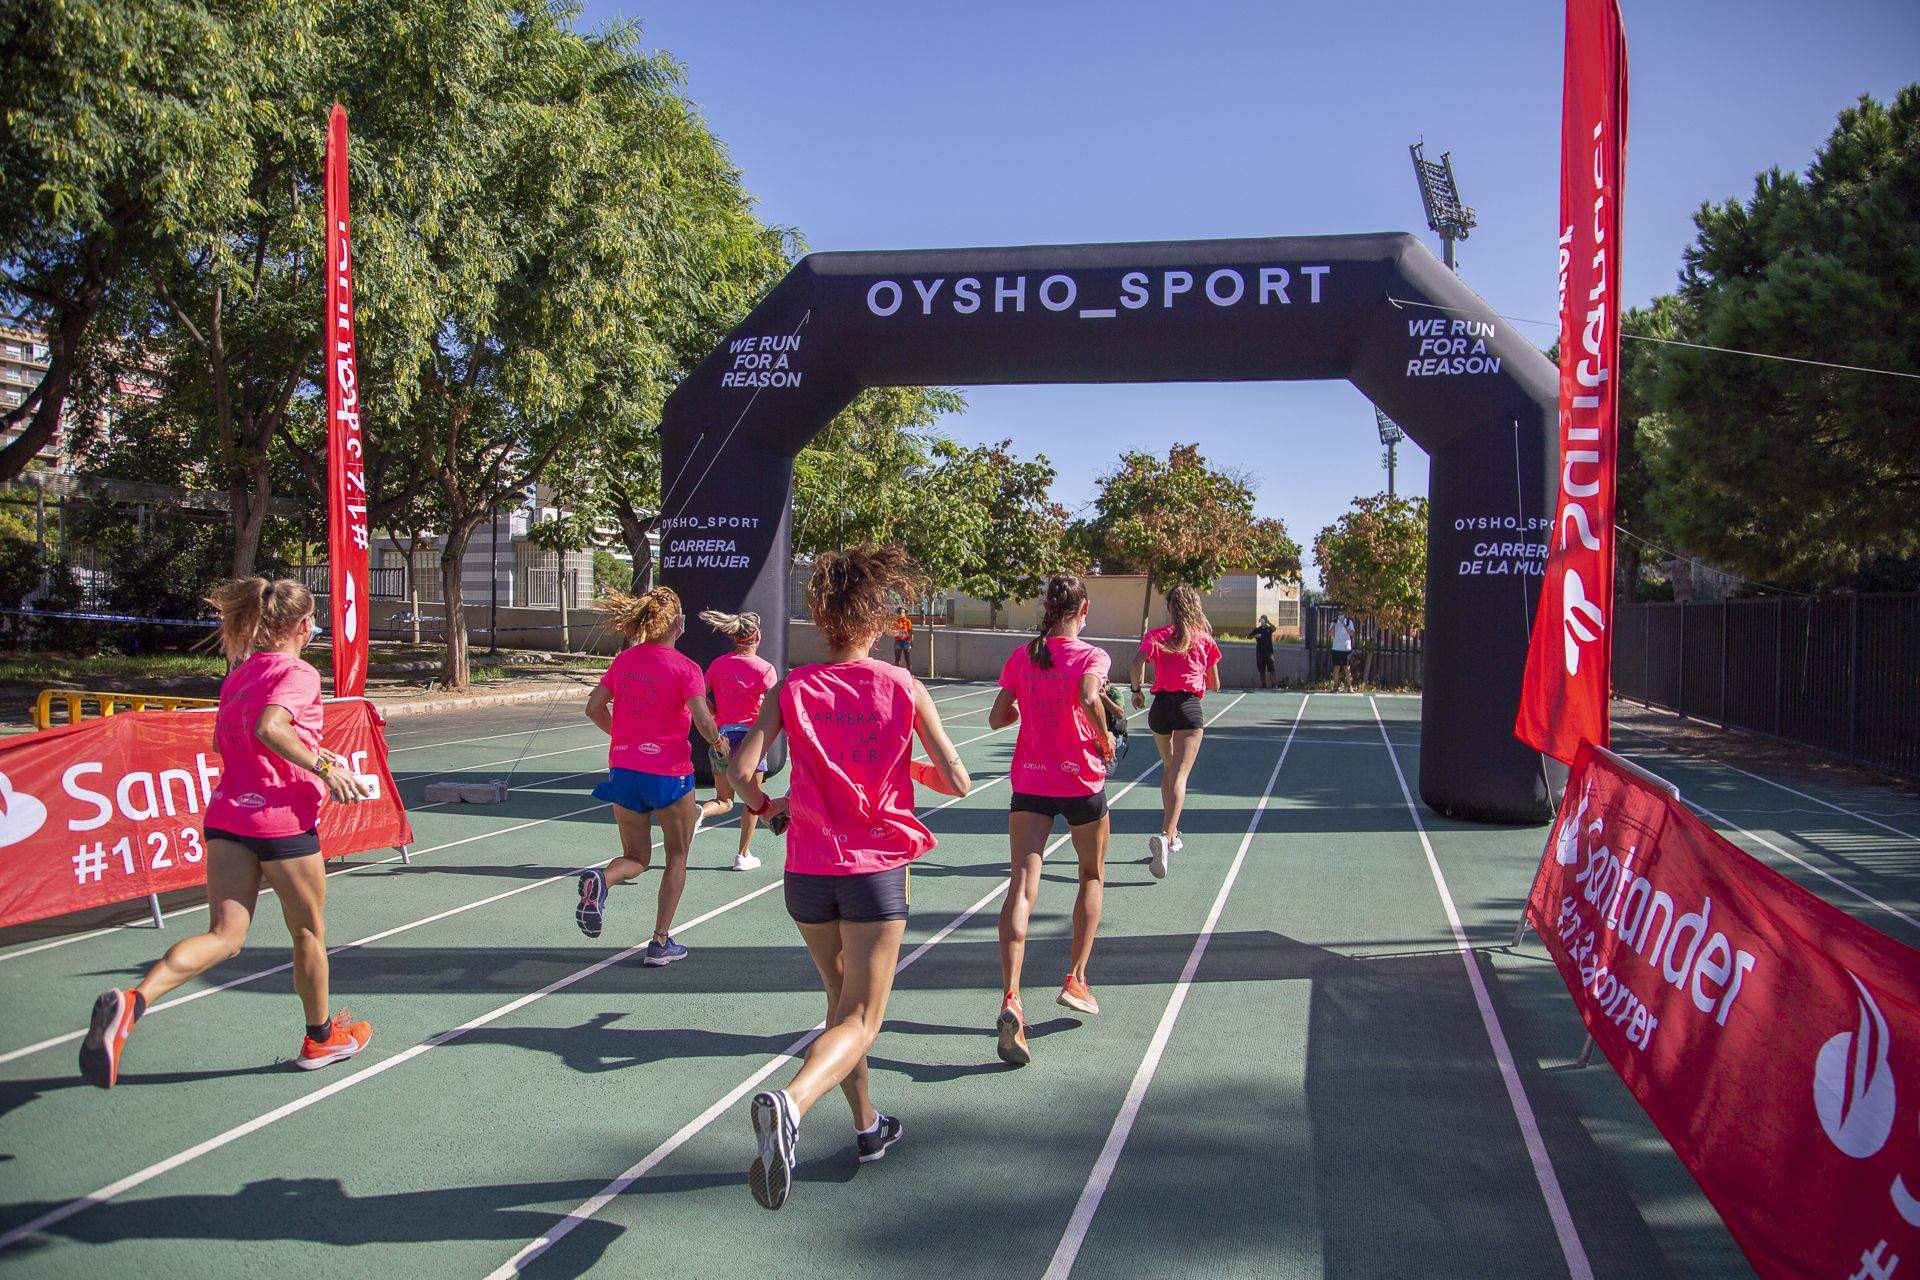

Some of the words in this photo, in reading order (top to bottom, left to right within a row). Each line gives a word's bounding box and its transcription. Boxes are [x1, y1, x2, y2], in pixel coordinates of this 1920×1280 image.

[867, 265, 1331, 318] OYSHO_SPORT
[1408, 319, 1446, 337] WE
[1450, 319, 1495, 338] RUN
[729, 336, 758, 354] WE
[758, 335, 801, 351] RUN
[1419, 337, 1468, 356] FOR
[1470, 338, 1487, 355] A
[733, 353, 773, 370] FOR
[774, 353, 789, 369] A
[1406, 356, 1501, 376] REASON
[721, 371, 802, 388] REASON
[661, 516, 760, 529] OYSHO_SPORT
[670, 539, 737, 553] CARRERA
[1474, 542, 1550, 559] CARRER
[663, 556, 675, 569] DE
[677, 555, 693, 568] LA
[696, 555, 750, 569] MUJER
[1458, 560, 1483, 575] DE
[1486, 560, 1509, 575] LA
[801, 710, 879, 725] CARRERA
[859, 730, 879, 744] LA
[1575, 816, 1756, 1027] Santander
